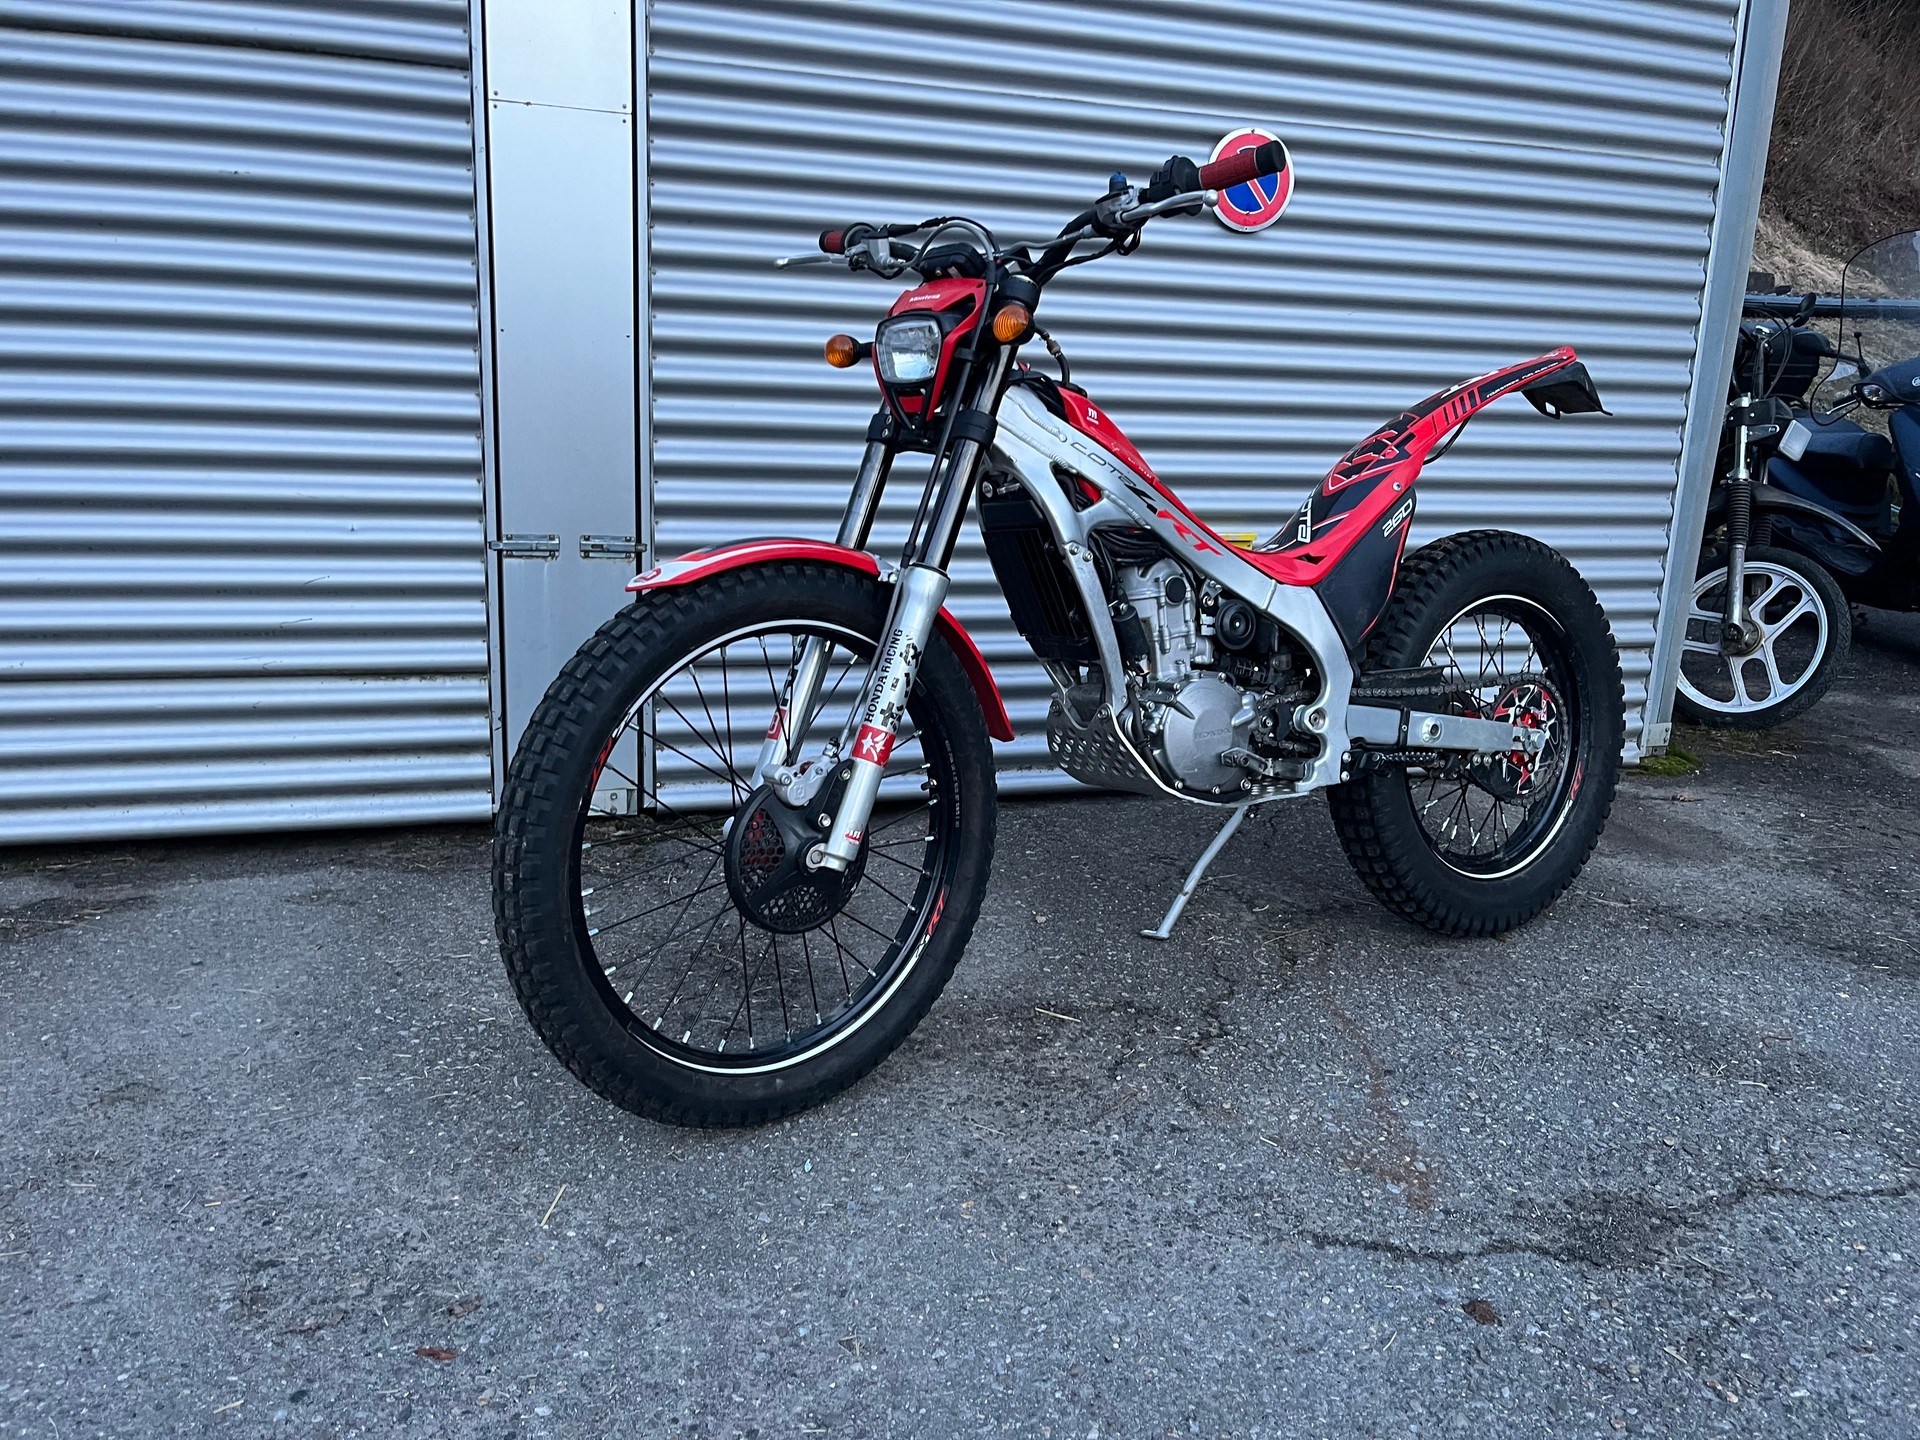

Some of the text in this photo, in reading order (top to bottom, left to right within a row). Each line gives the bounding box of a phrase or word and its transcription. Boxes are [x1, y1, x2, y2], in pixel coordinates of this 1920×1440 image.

[1382, 498, 1414, 538] 260
[864, 674, 889, 724] HONDA
[881, 628, 904, 673] RACING
